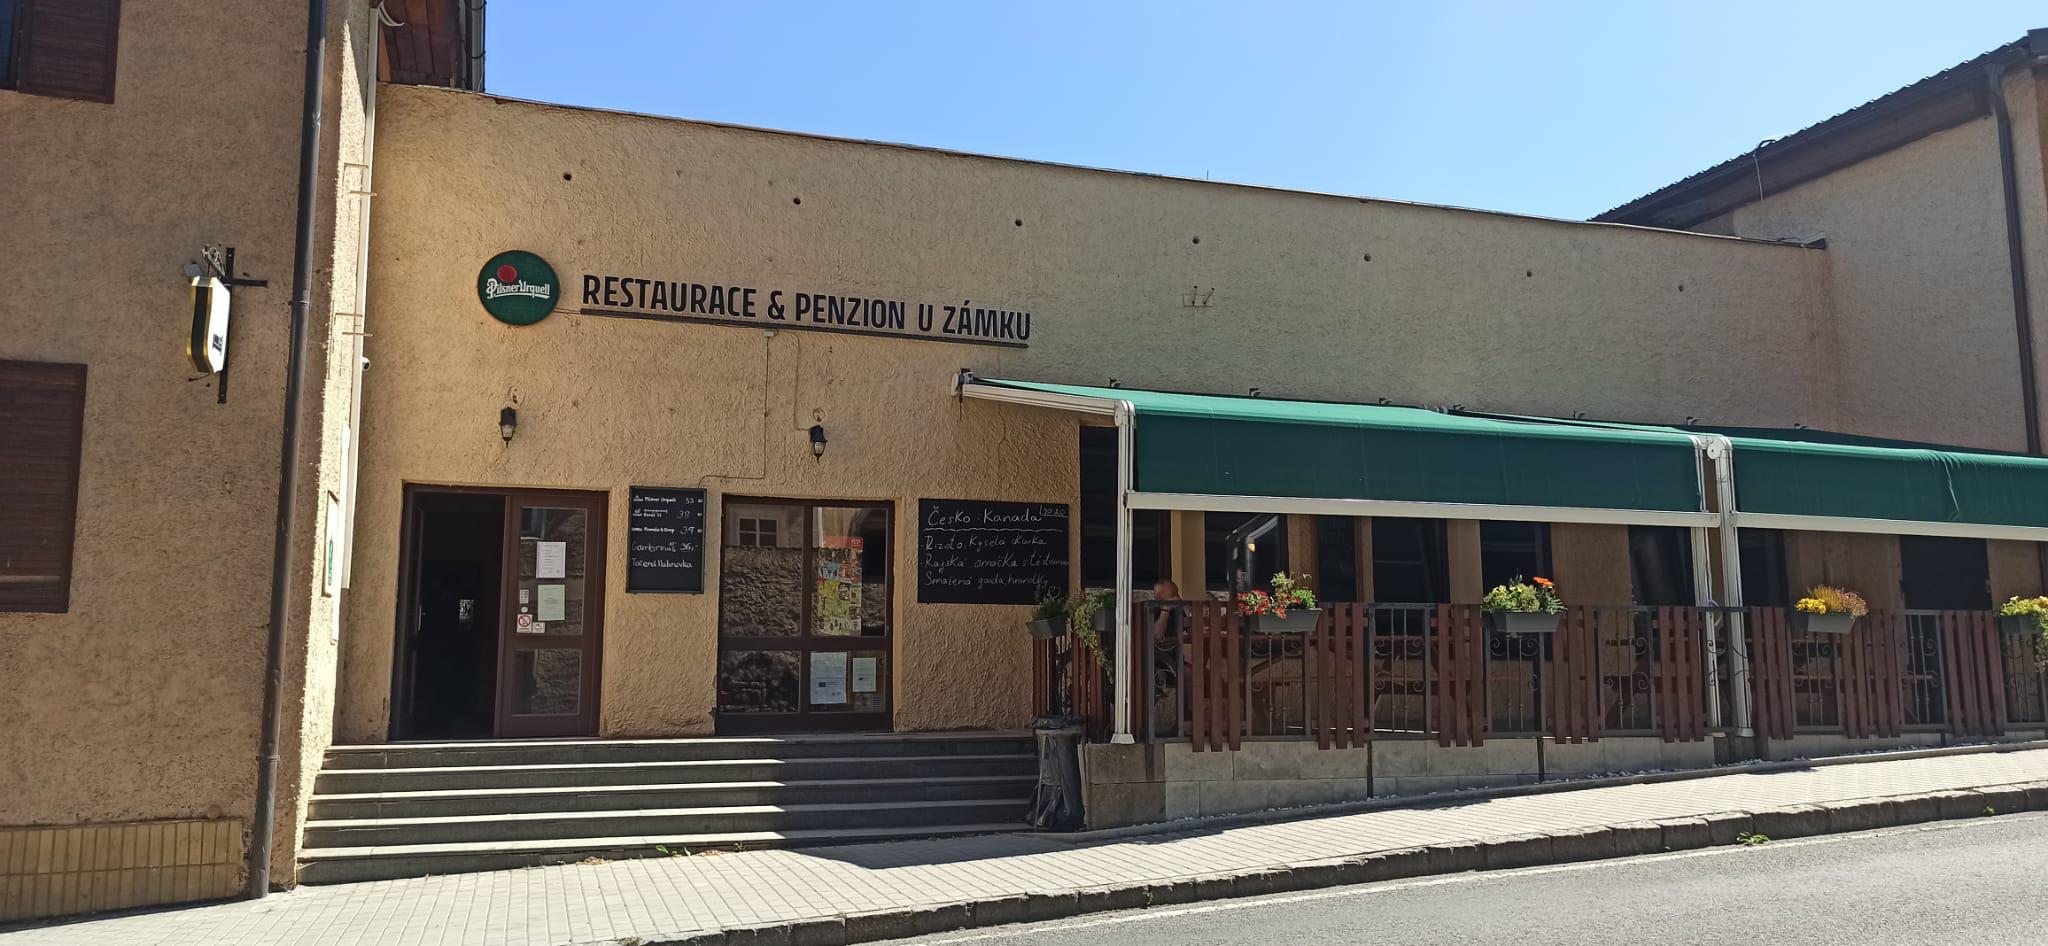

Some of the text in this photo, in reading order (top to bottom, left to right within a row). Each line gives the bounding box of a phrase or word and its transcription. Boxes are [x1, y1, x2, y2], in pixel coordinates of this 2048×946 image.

[486, 277, 550, 299] Pilsner Urquell
[582, 275, 1031, 341] RESTAURACE & PENZION U ZÁMKU
[927, 505, 971, 526] Česko
[983, 507, 1042, 524] Kanada
